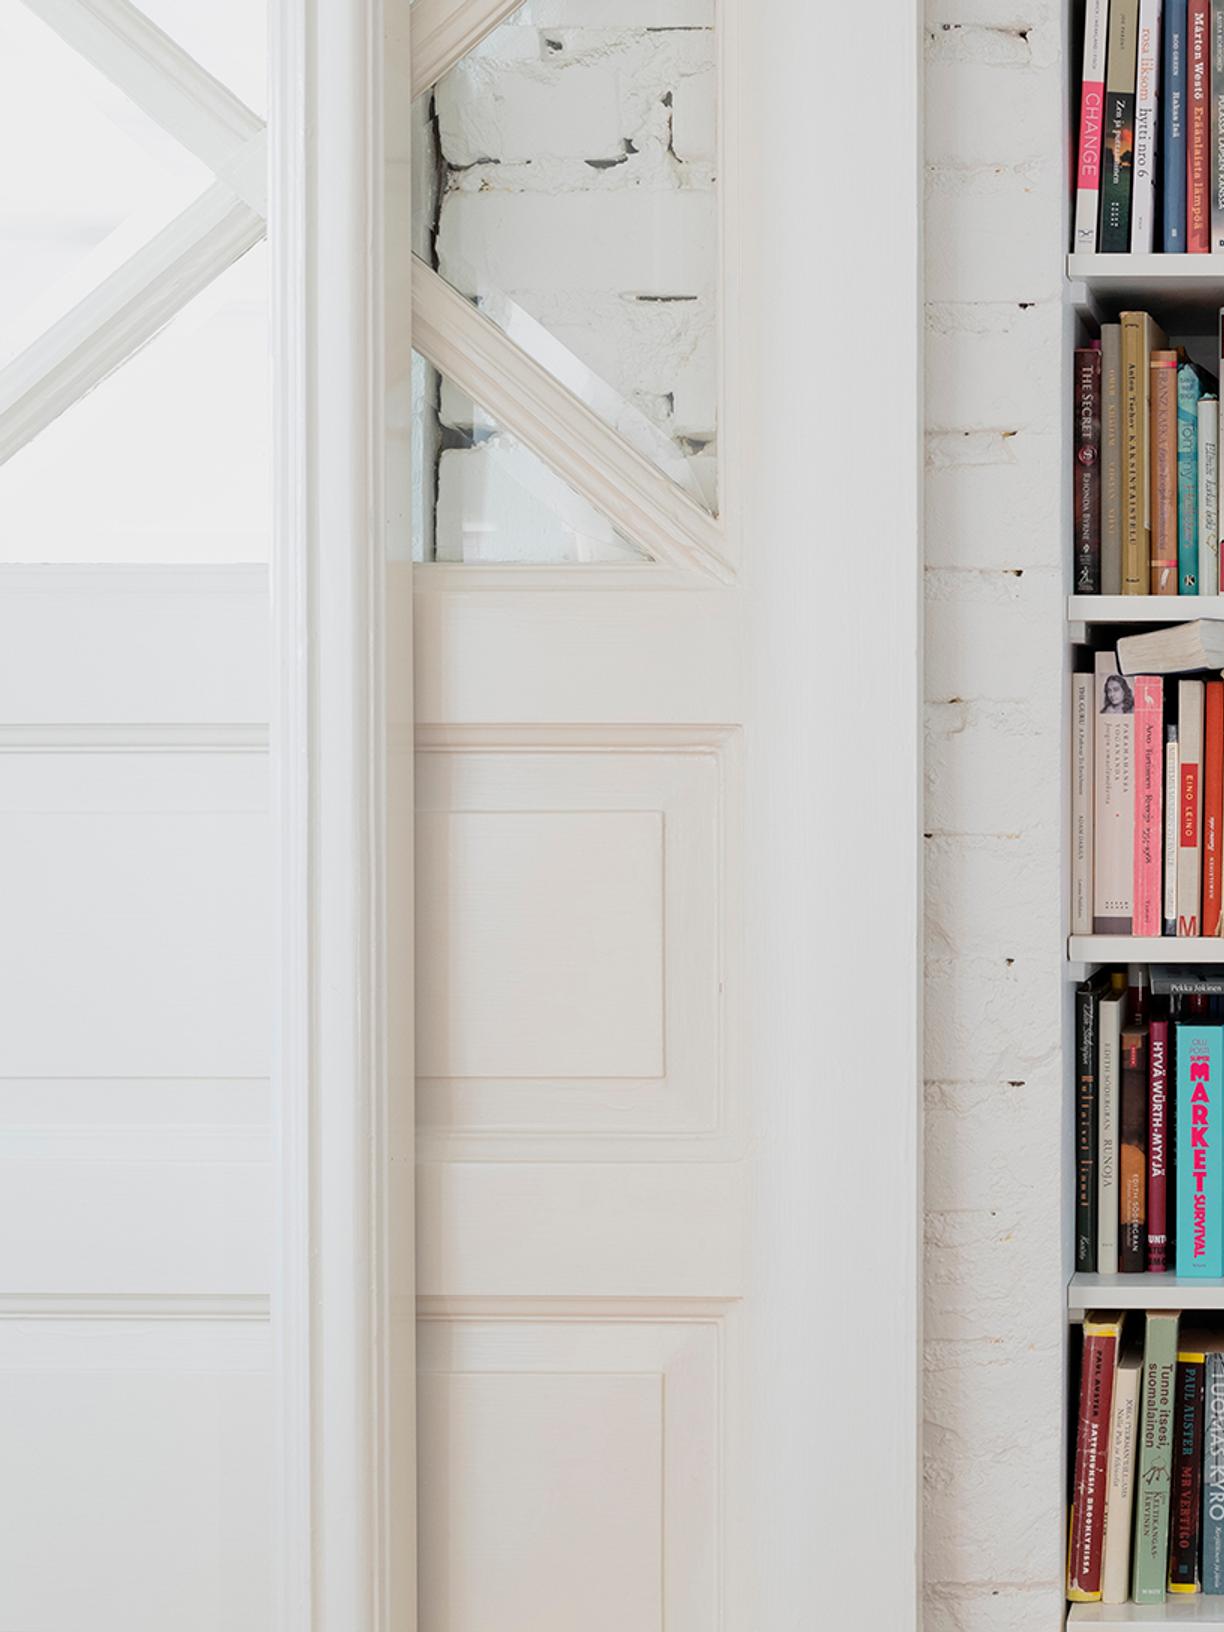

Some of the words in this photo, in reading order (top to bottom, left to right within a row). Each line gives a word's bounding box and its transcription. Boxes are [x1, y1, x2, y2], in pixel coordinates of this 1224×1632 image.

[1141, 28, 1150, 53] rosa
[1194, 13, 1204, 59] Mårten
[1140, 58, 1151, 101] liksom
[1194, 63, 1204, 100] Westö
[1115, 100, 1125, 117] Zen
[1136, 108, 1151, 140] hytti
[1082, 93, 1100, 176] CHANGE
[1137, 144, 1146, 167] nro
[1194, 107, 1204, 179] Eräänlaista
[1191, 183, 1203, 229] lämpöä
[1081, 365, 1093, 391] THE
[1128, 363, 1137, 391] Anton
[1081, 394, 1093, 439] SECRET
[1180, 419, 1195, 479] Tommy
[1082, 472, 1091, 511] RHONDA
[1128, 435, 1137, 545] KAKSINTAISTELU
[1146, 724, 1155, 744] Arvo
[1184, 775, 1194, 800] EINO
[1184, 806, 1194, 837] LEINO
[1152, 1041, 1166, 1077] HYVÄ
[1103, 1073, 1112, 1131] SÖDERGRAN
[1152, 1080, 1166, 1177] WÜRTH-MYYJÄ
[1102, 1139, 1113, 1188] RUNOJA
[1131, 1200, 1140, 1251] SÖDERGRAN
[1193, 1194, 1206, 1258] SURVIVAL
[1092, 1379, 1101, 1417] AUSTER
[1159, 1363, 1173, 1405] Tunne
[1183, 1368, 1196, 1401] PAUL
[1144, 1363, 1159, 1448] suomalainen
[1156, 1409, 1171, 1450] itsesi,
[1182, 1404, 1195, 1456] AUSTER
[1087, 1423, 1100, 1495] SATTUMUKSIA
[1181, 1466, 1192, 1486] MR
[1179, 1492, 1191, 1549] VERTIGO
